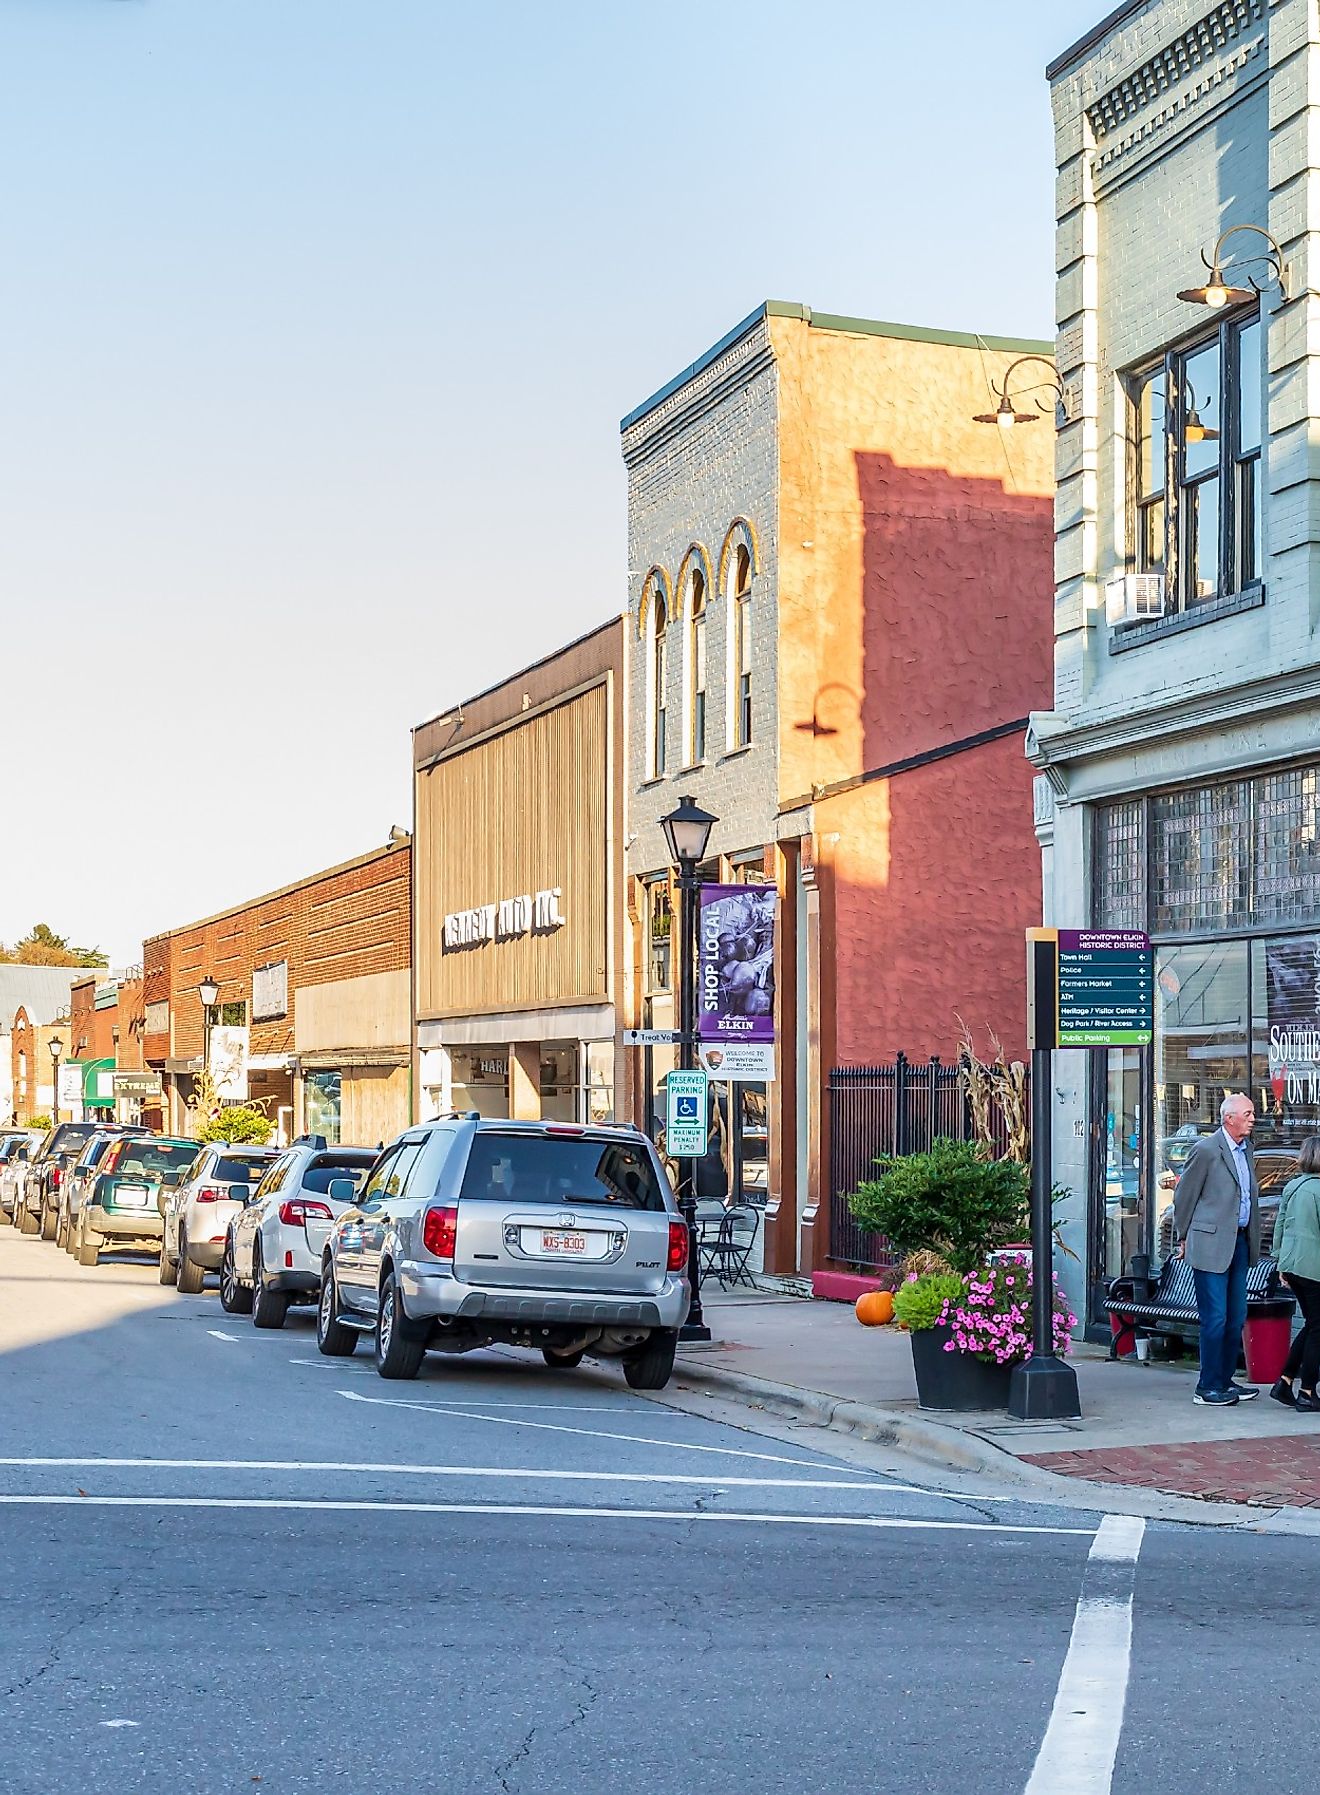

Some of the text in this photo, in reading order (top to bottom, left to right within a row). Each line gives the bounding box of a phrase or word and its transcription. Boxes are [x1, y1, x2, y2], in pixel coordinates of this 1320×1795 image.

[705, 907, 721, 1011] SHOP LOCAL
[1061, 1007, 1089, 1015] Heritage
[718, 1021, 754, 1030] ELKIN
[640, 1033, 672, 1041] Treat Vo
[1084, 1034, 1110, 1042] Parking
[670, 1076, 705, 1085] RESERVED
[671, 1086, 703, 1094] PARKING
[1287, 1072, 1303, 1104] ON
